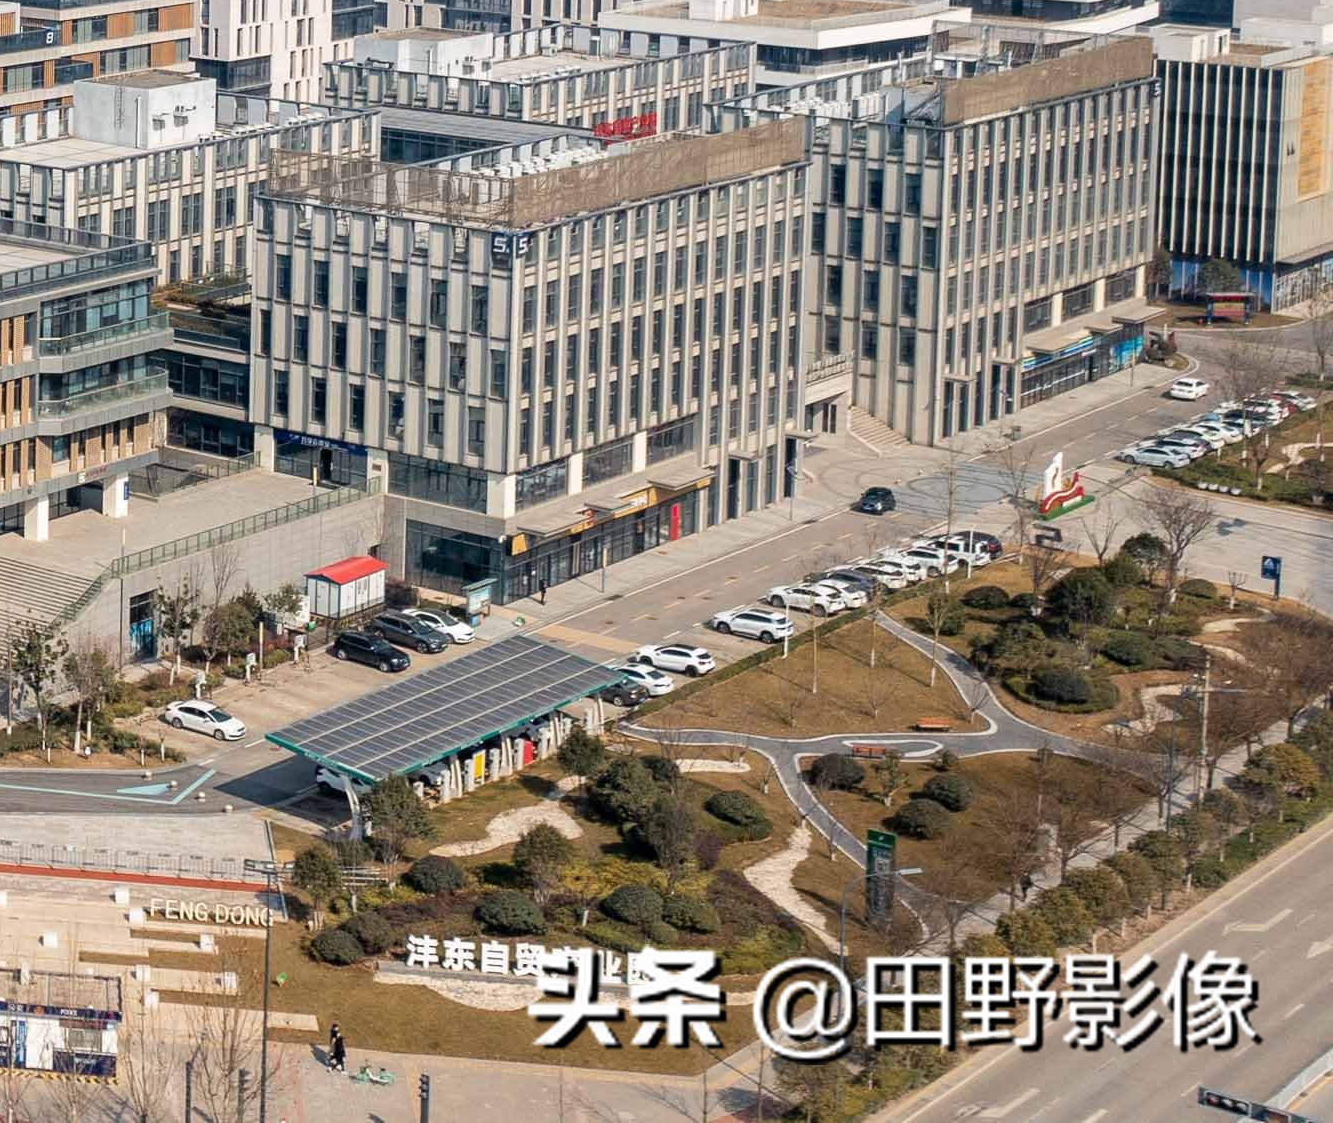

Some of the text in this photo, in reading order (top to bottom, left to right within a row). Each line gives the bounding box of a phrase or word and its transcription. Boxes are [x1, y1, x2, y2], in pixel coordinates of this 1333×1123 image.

[45, 32, 54, 44] 8
[150, 897, 274, 927] FENG DONG
[405, 934, 663, 986] 沣东自贸业
